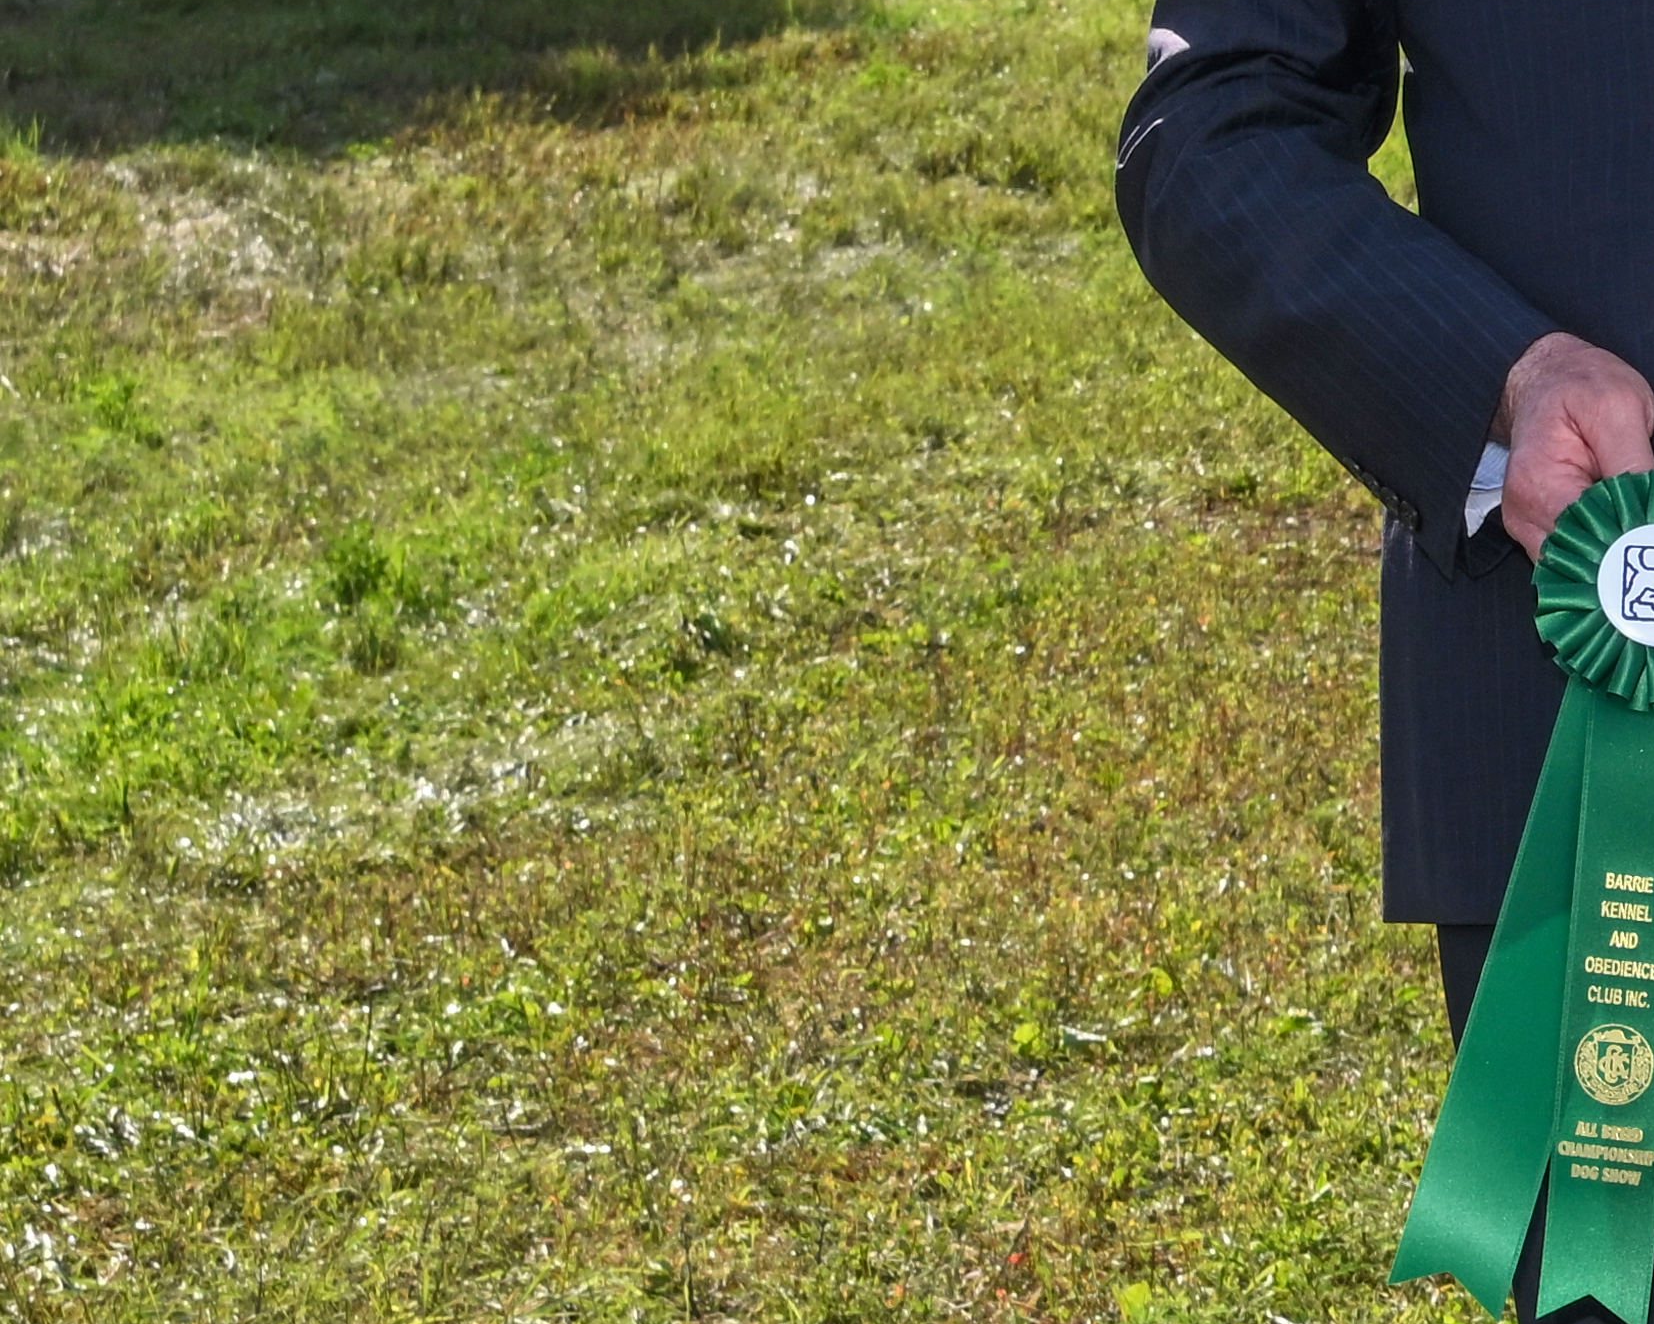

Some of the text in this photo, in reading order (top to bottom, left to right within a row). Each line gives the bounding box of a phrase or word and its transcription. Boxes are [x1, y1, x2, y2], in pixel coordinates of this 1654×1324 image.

[1605, 872, 1654, 893] BARRIE
[1601, 900, 1653, 923] KENNEL
[1609, 930, 1639, 949] AND
[1587, 985, 1651, 1009] CLUB INC.
[1574, 1120, 1598, 1138] ALL
[1571, 1163, 1600, 1181] DOG
